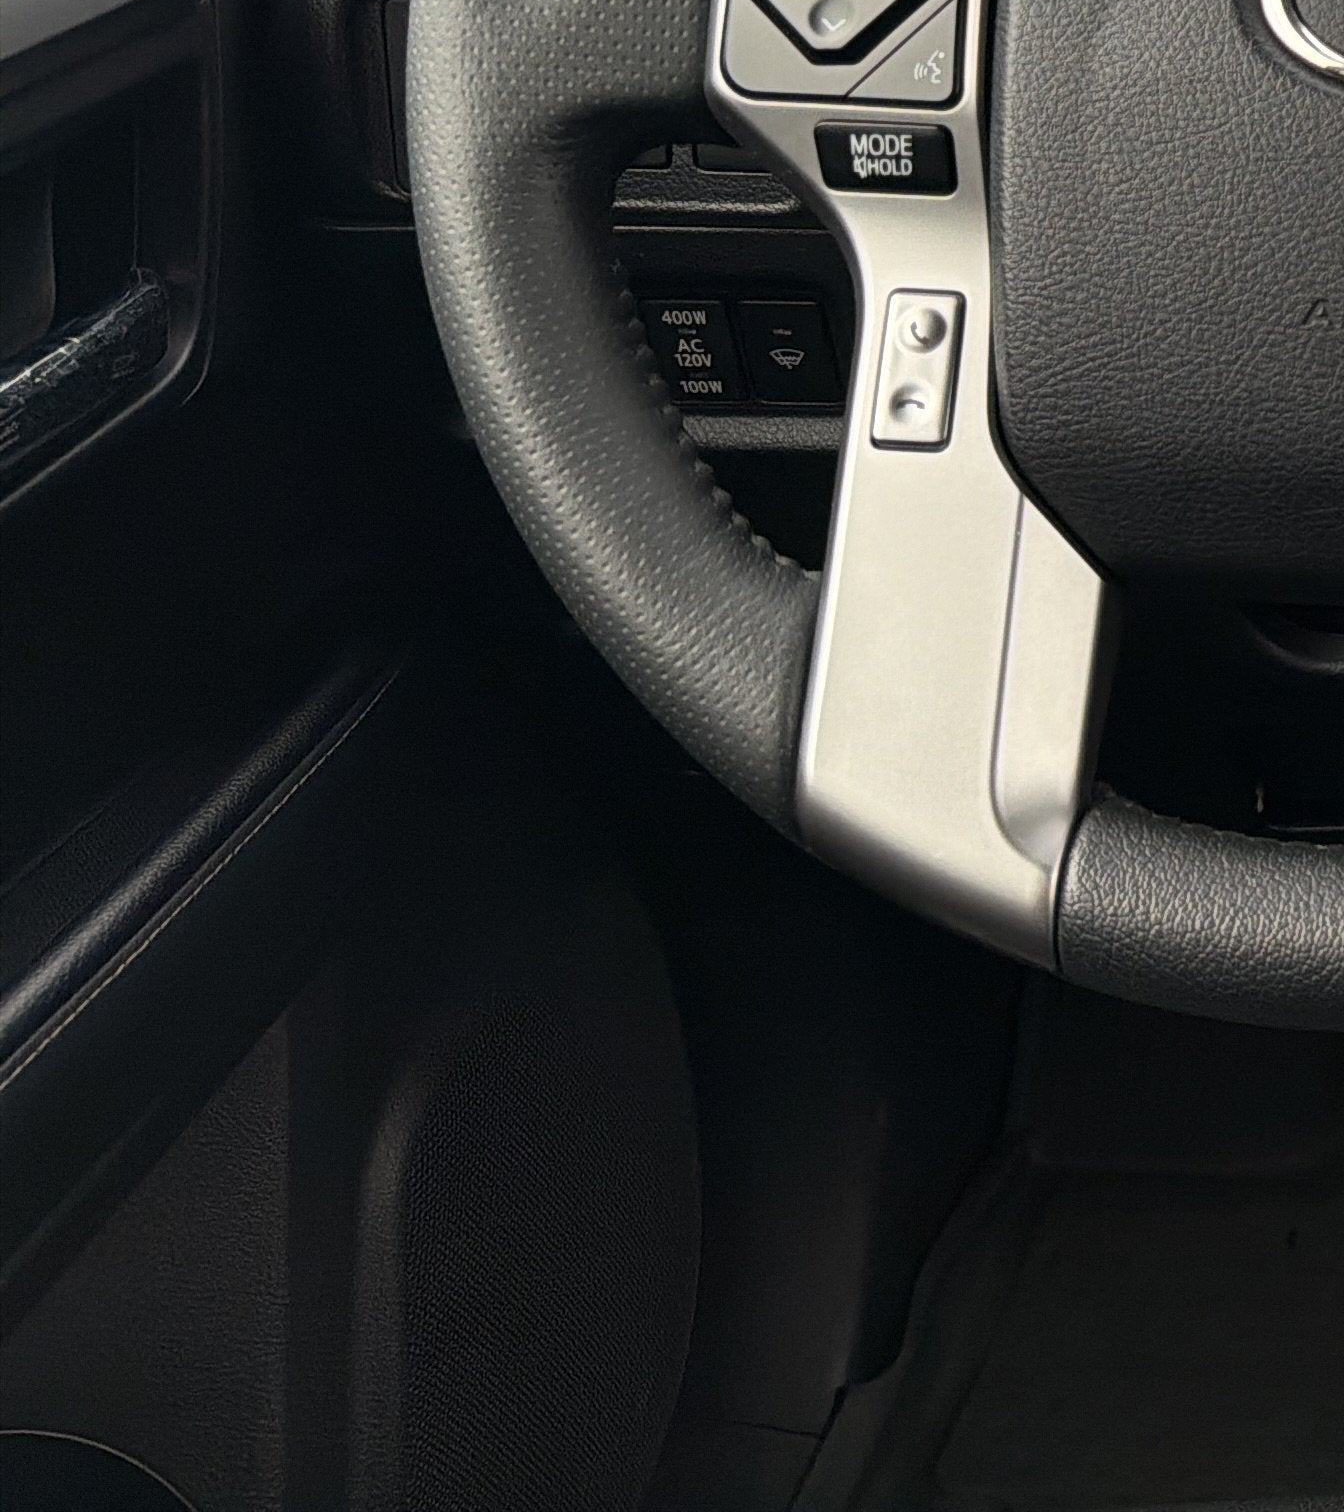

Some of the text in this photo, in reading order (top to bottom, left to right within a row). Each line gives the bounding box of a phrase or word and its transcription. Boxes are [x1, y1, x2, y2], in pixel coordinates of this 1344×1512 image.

[849, 134, 914, 157] MODE
[867, 158, 913, 176] HOLD
[661, 310, 708, 326] 400W
[677, 338, 706, 354] AC
[673, 353, 713, 368] 120V
[679, 380, 723, 394] 100W
